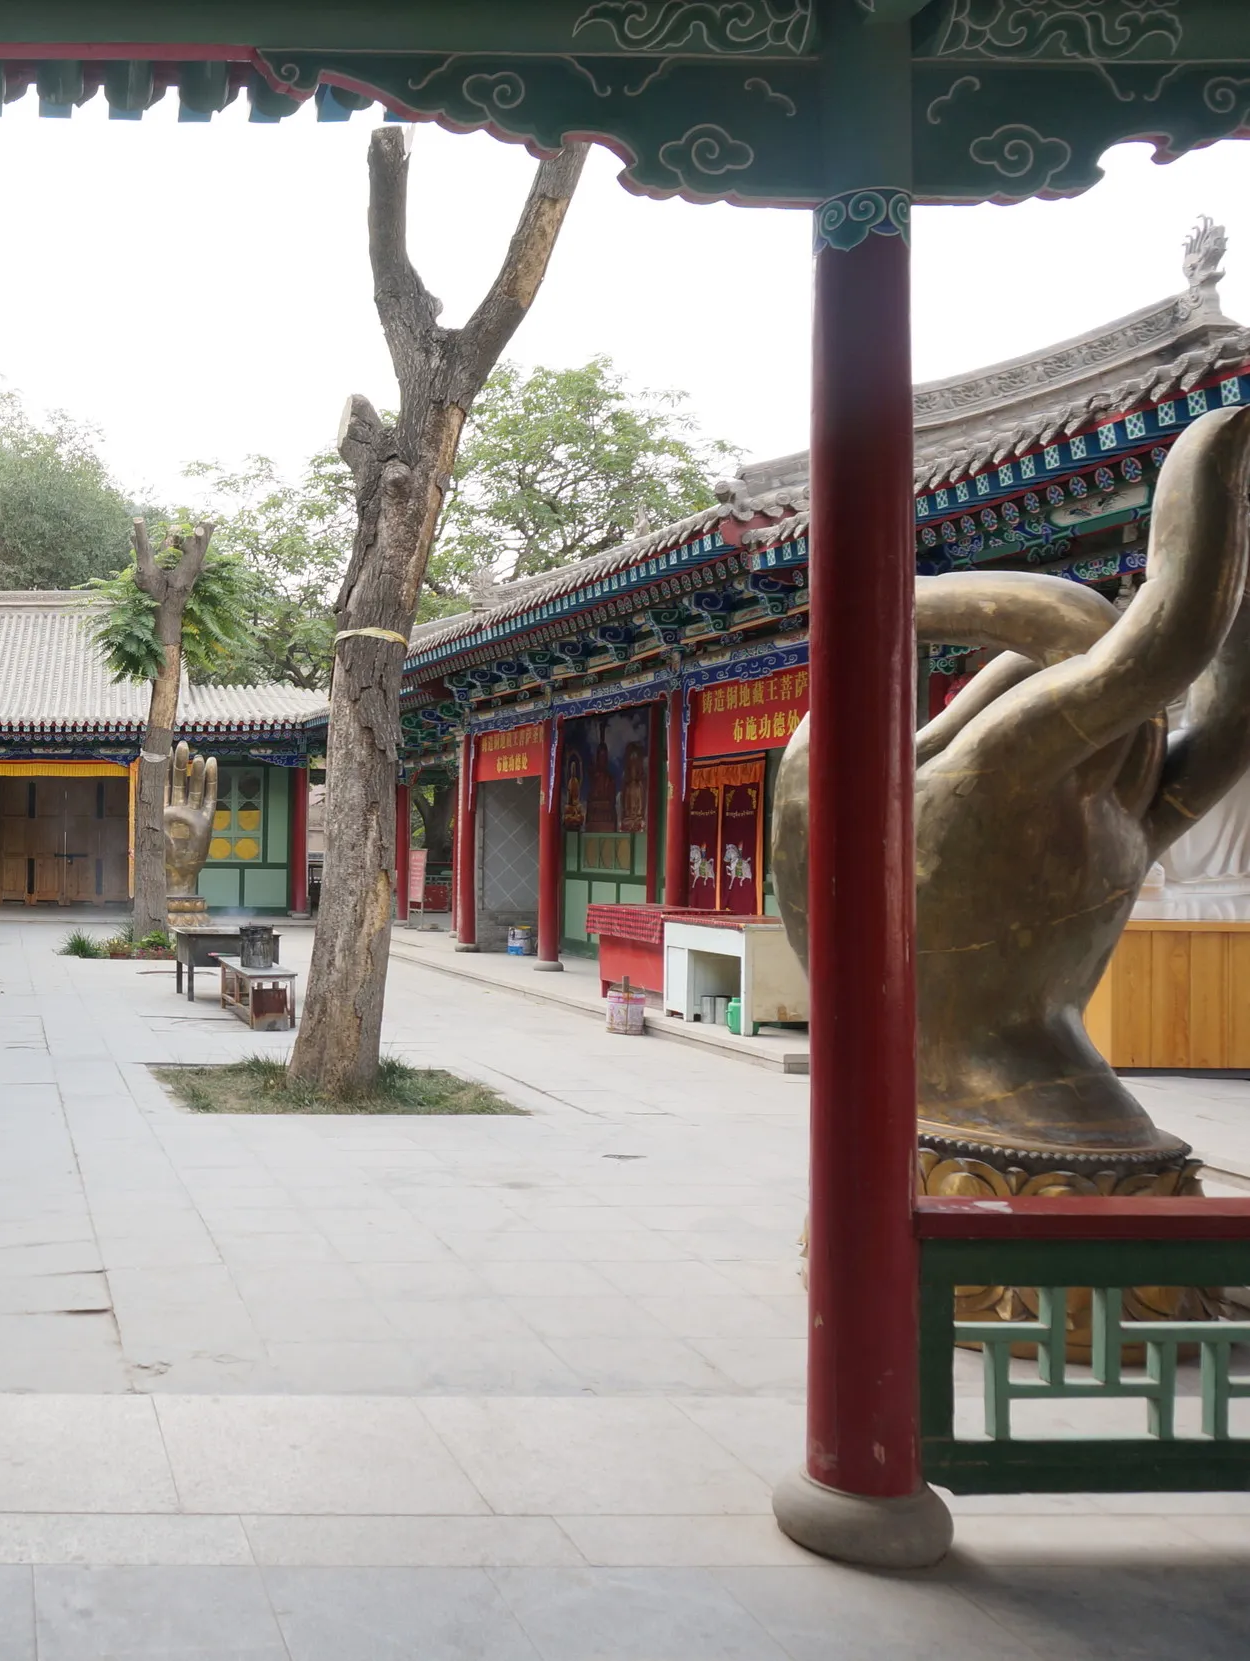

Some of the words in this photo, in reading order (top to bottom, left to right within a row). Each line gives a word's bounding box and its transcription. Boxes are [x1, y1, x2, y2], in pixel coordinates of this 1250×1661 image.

[732, 709, 801, 743] 布施功德处
